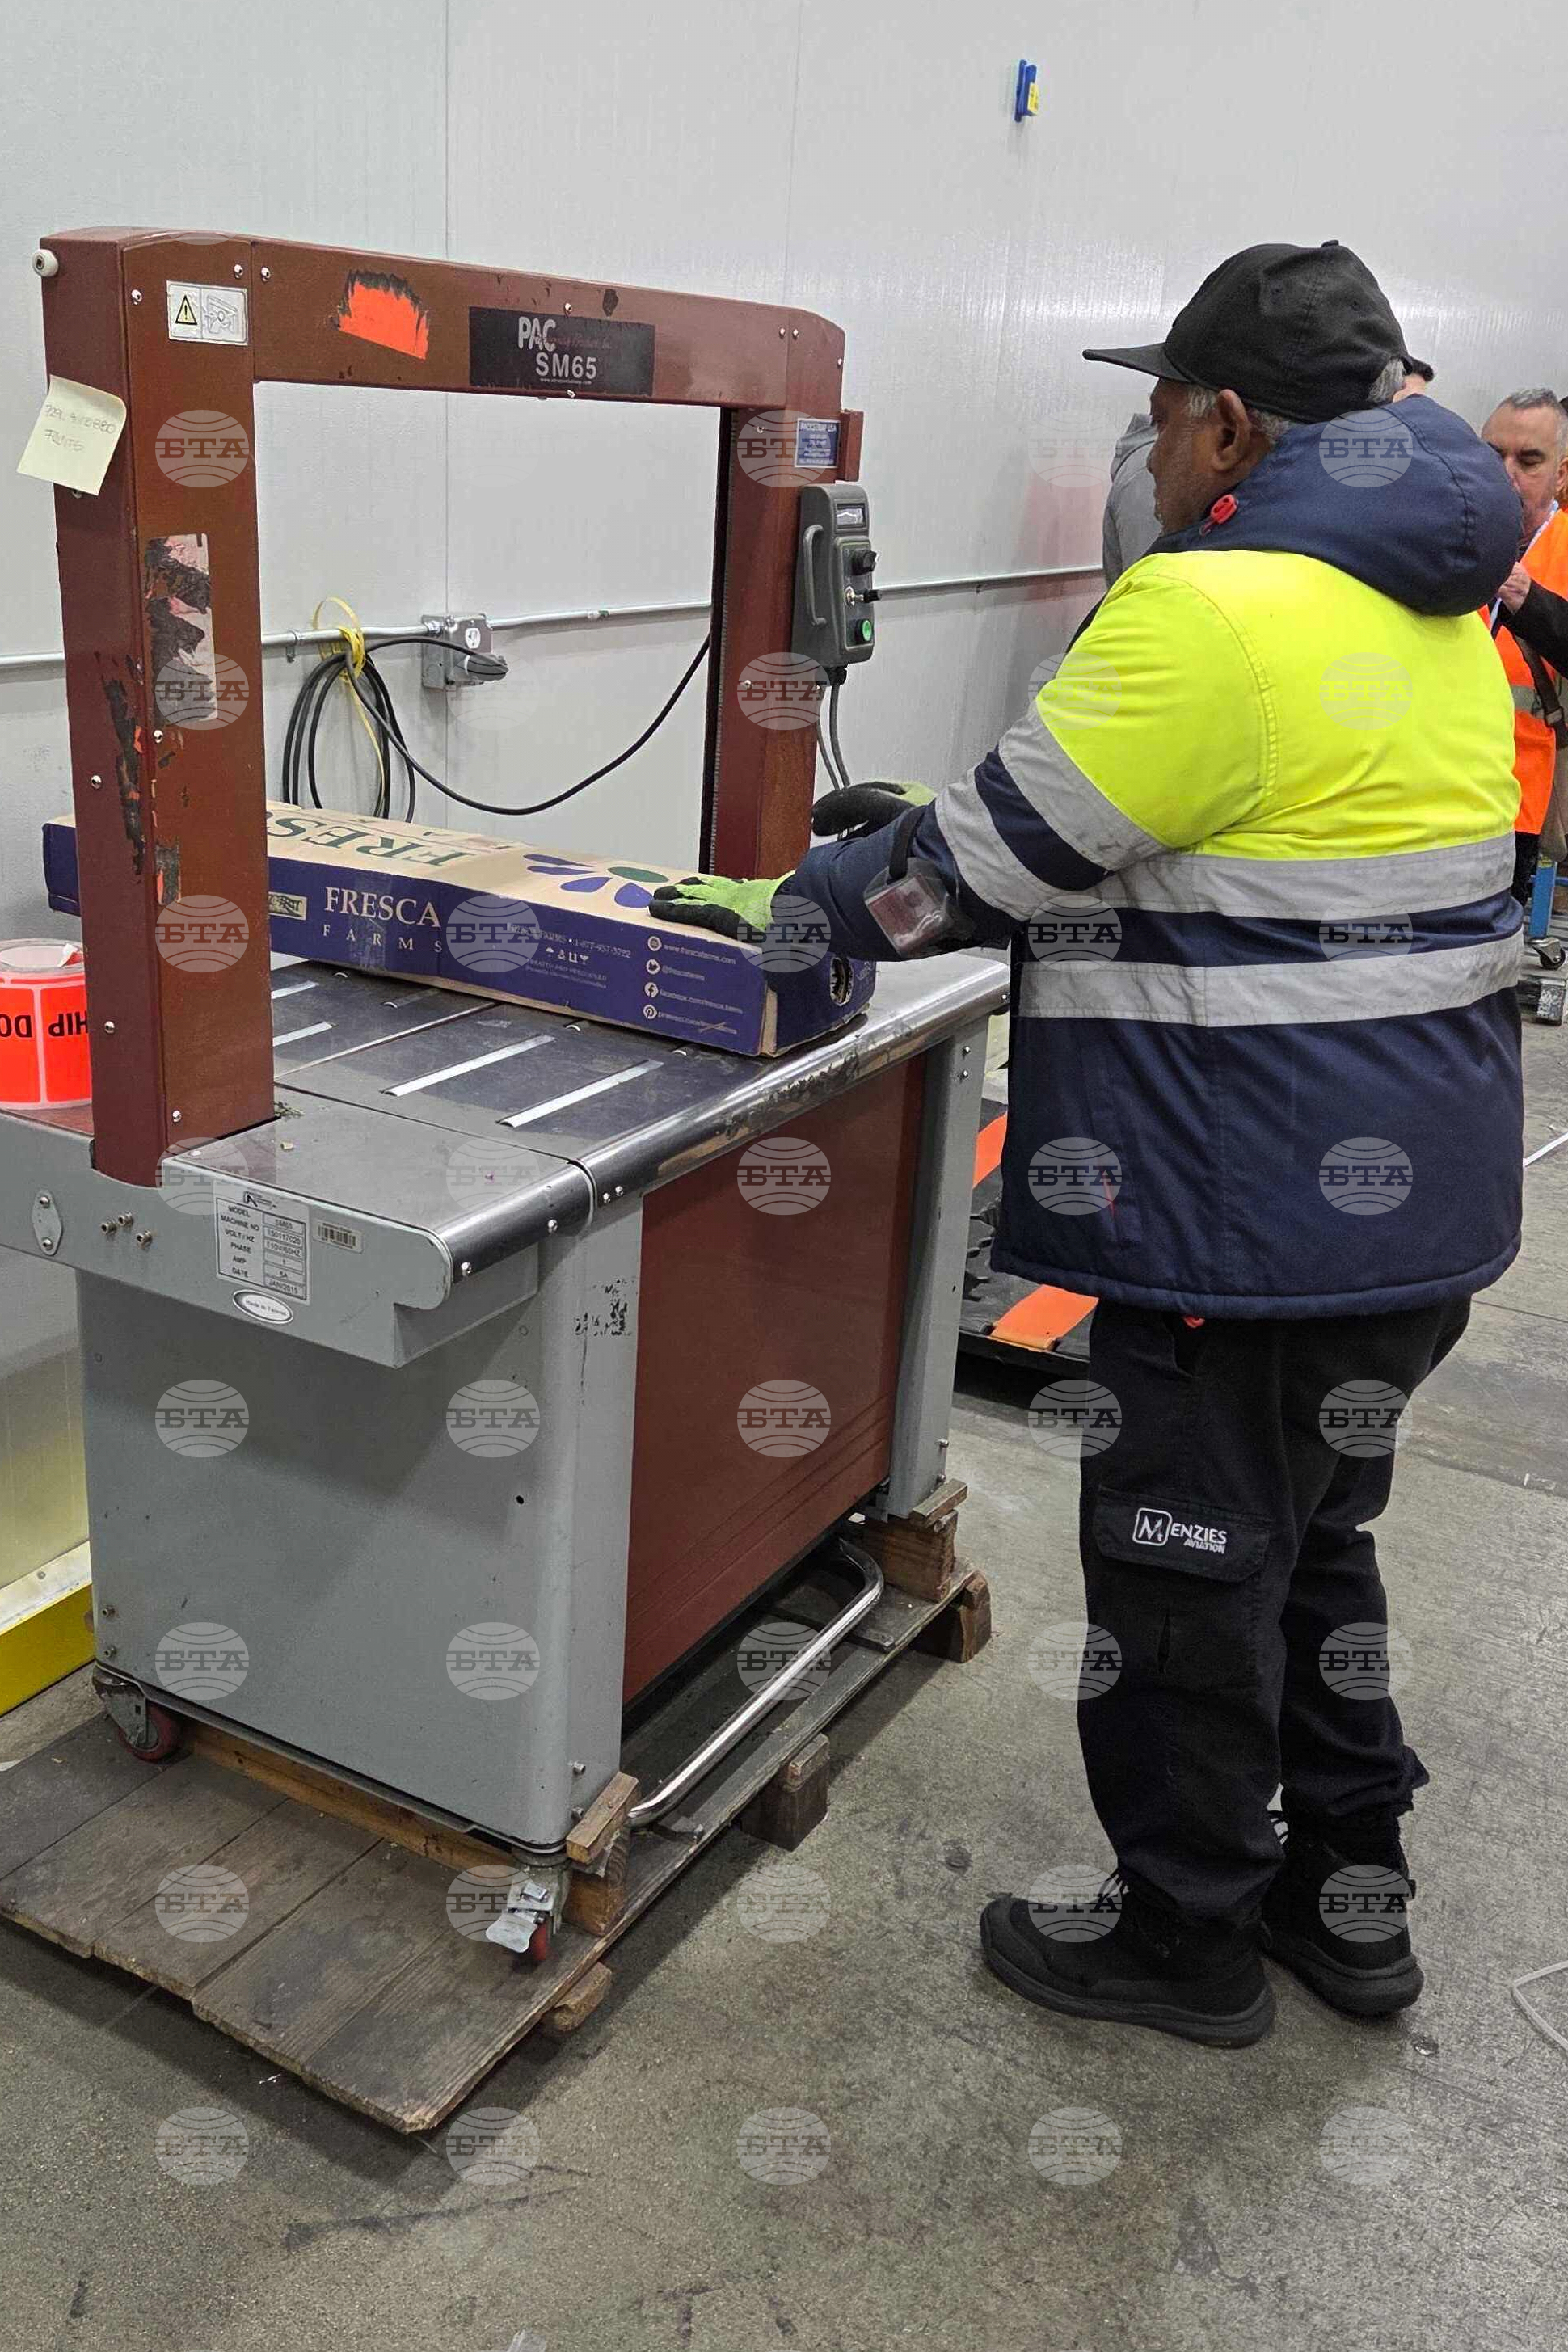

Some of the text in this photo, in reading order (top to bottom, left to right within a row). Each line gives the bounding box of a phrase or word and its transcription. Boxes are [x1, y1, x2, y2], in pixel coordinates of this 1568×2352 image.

[518, 315, 557, 352] PAC
[535, 352, 598, 380] SM65
[266, 811, 478, 867] FRES
[324, 886, 442, 928] FRESCA
[322, 923, 444, 954] FARMS
[227, 1205, 251, 1218] MODEL
[220, 1214, 250, 1230] MACHINE
[224, 1228, 242, 1239] VOLT
[230, 1242, 252, 1254] PHASE
[232, 1254, 247, 1265] AMP
[231, 1267, 250, 1279] DATE
[1137, 1515, 1228, 1545] MENZIES
[1183, 1538, 1226, 1555] AVIATION
